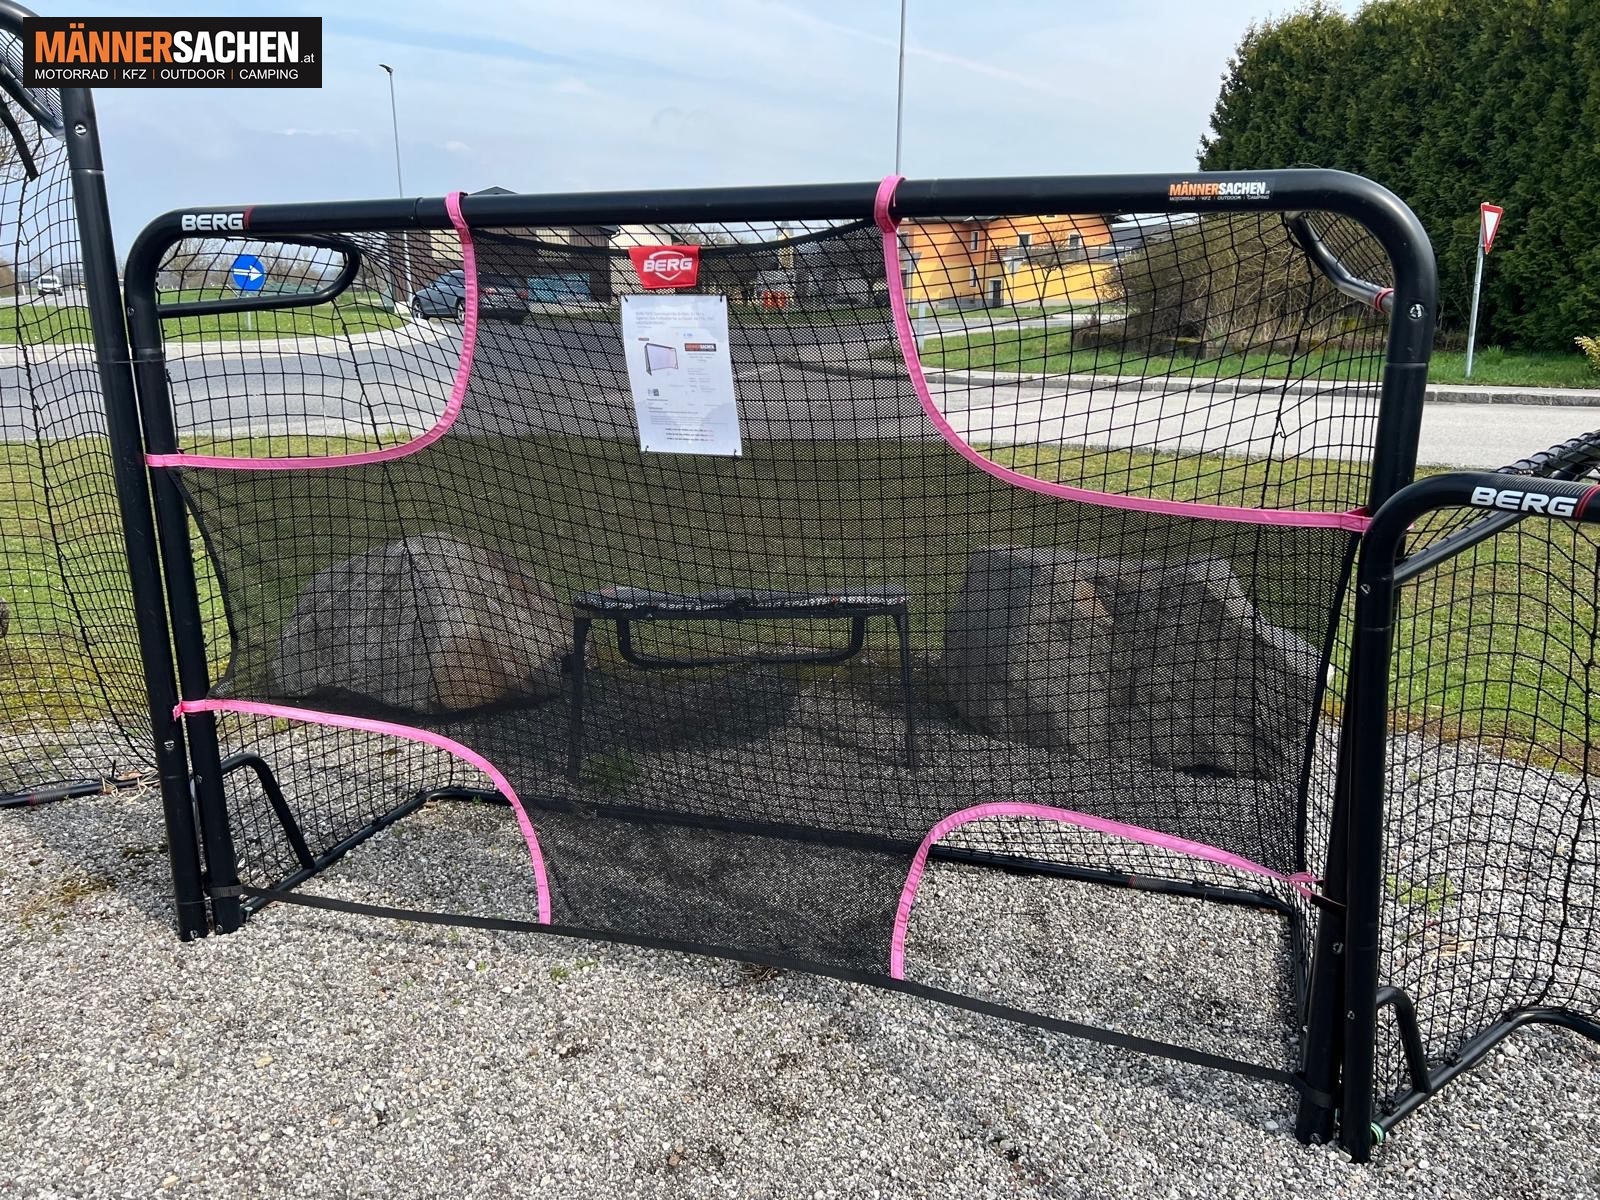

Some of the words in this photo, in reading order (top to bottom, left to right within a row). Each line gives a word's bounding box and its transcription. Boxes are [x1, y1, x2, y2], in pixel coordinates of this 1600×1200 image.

[181, 213, 244, 231] BERG
[643, 257, 693, 273] BERG
[1470, 486, 1578, 517] BERG
